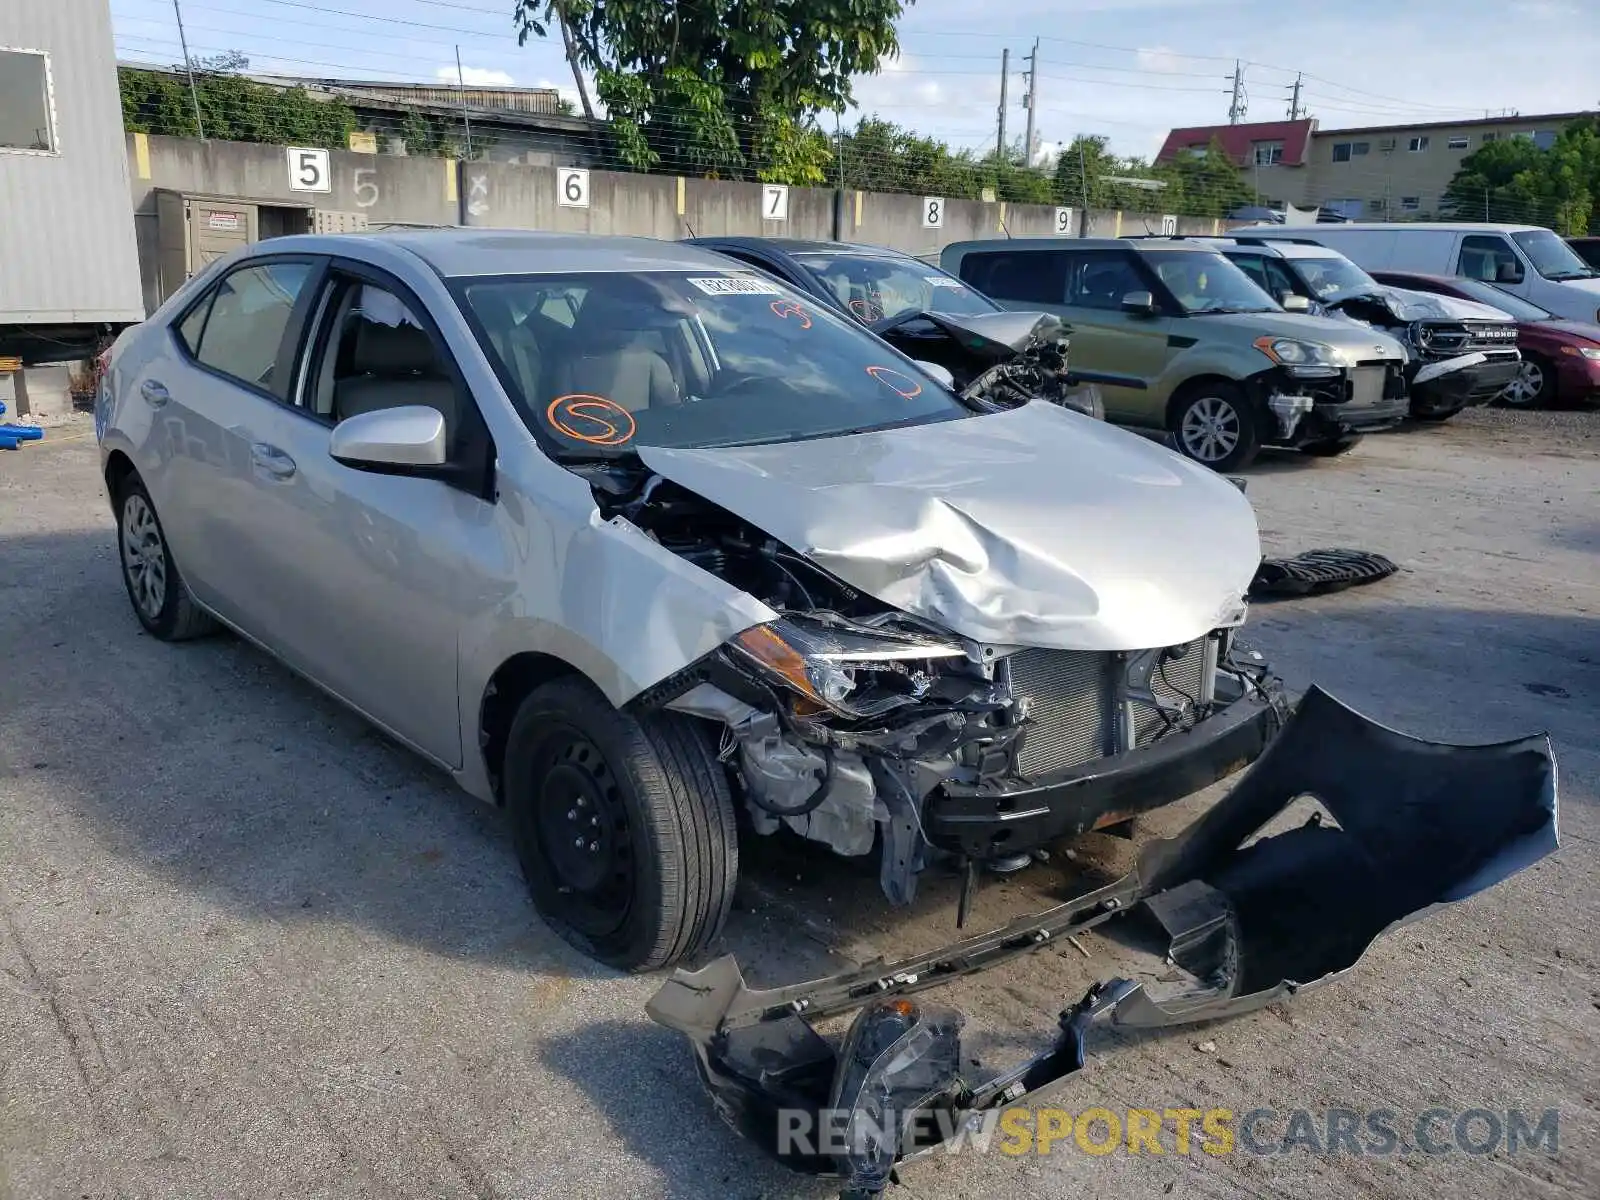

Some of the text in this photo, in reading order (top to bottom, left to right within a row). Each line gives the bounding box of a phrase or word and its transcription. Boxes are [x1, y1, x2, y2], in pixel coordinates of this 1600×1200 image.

[300, 153, 320, 186] 5
[354, 168, 379, 207] 5
[566, 173, 582, 202] 6
[769, 189, 782, 214] 7
[928, 201, 939, 224] 8
[1059, 211, 1068, 231] 9
[1163, 218, 1175, 236] 10
